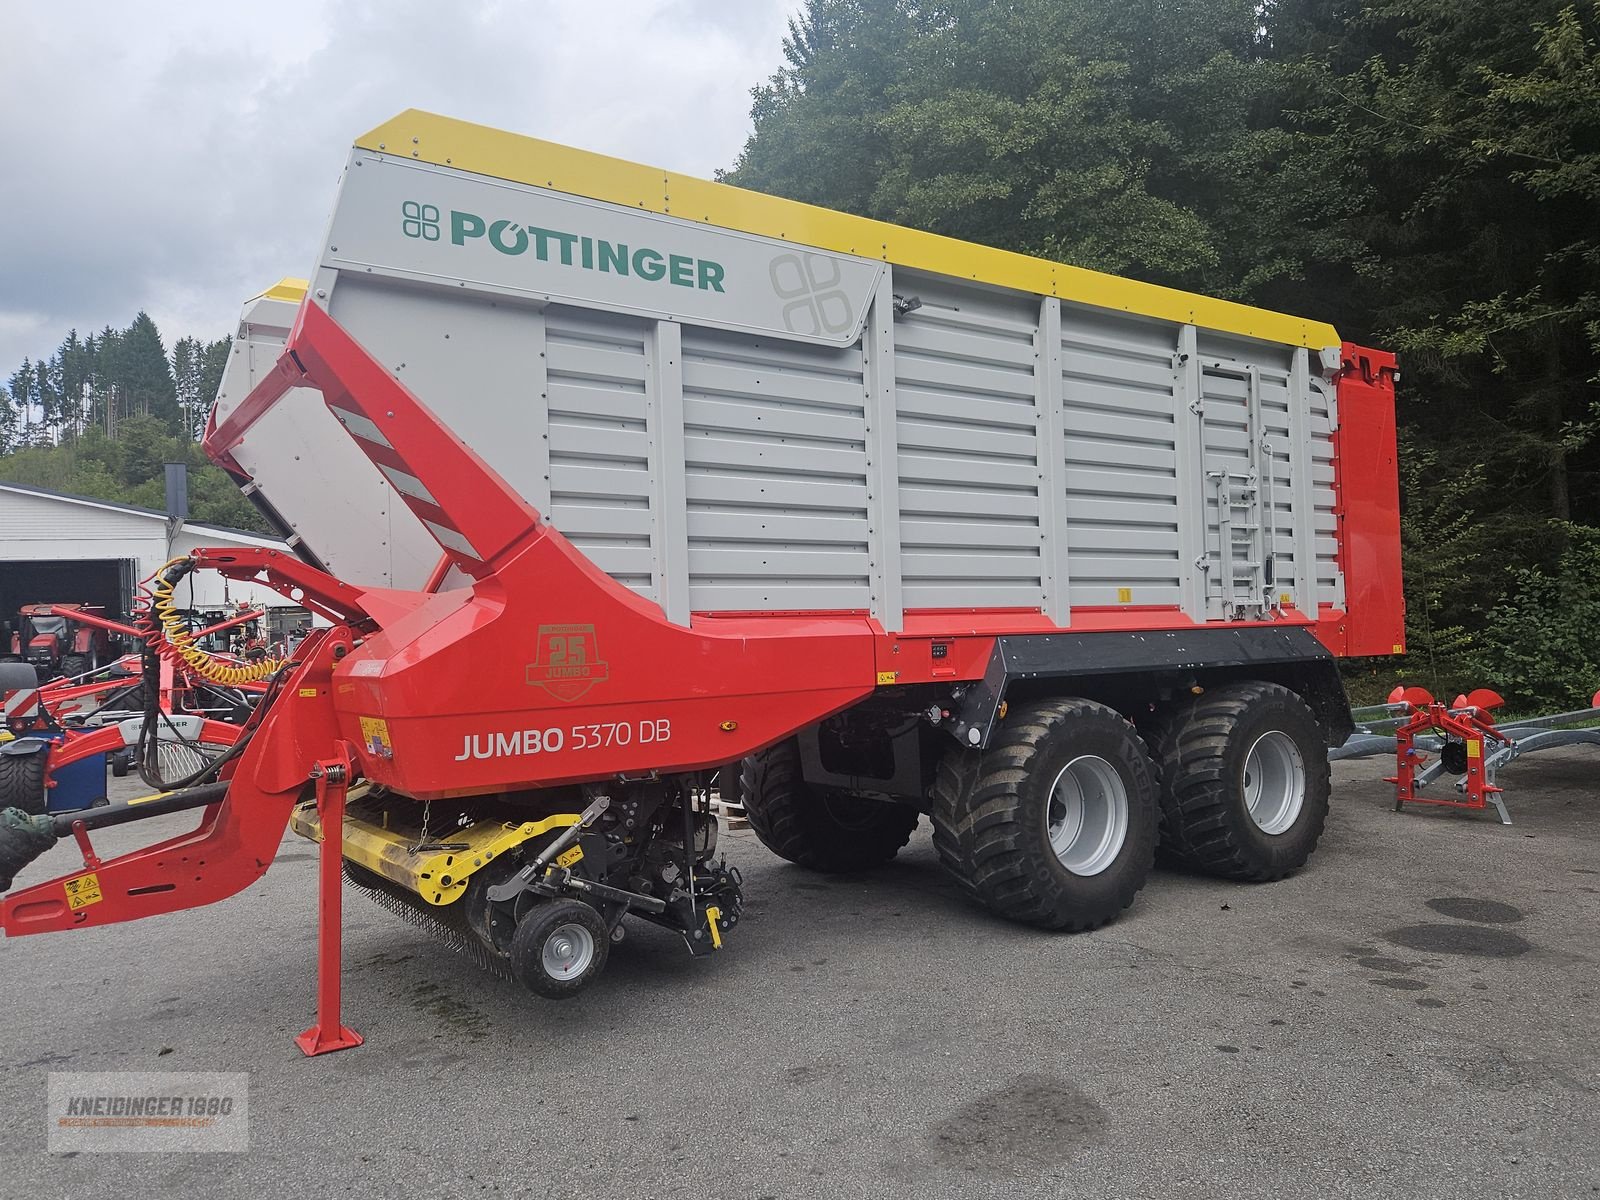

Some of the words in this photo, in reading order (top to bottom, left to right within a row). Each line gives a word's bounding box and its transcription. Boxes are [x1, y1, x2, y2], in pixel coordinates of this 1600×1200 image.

[451, 210, 726, 293] PÖTTINGER
[550, 636, 586, 665] 25
[546, 666, 591, 679] JUMBO
[455, 728, 564, 761] JUMBO
[572, 722, 632, 750] 5370
[639, 719, 671, 743] DB
